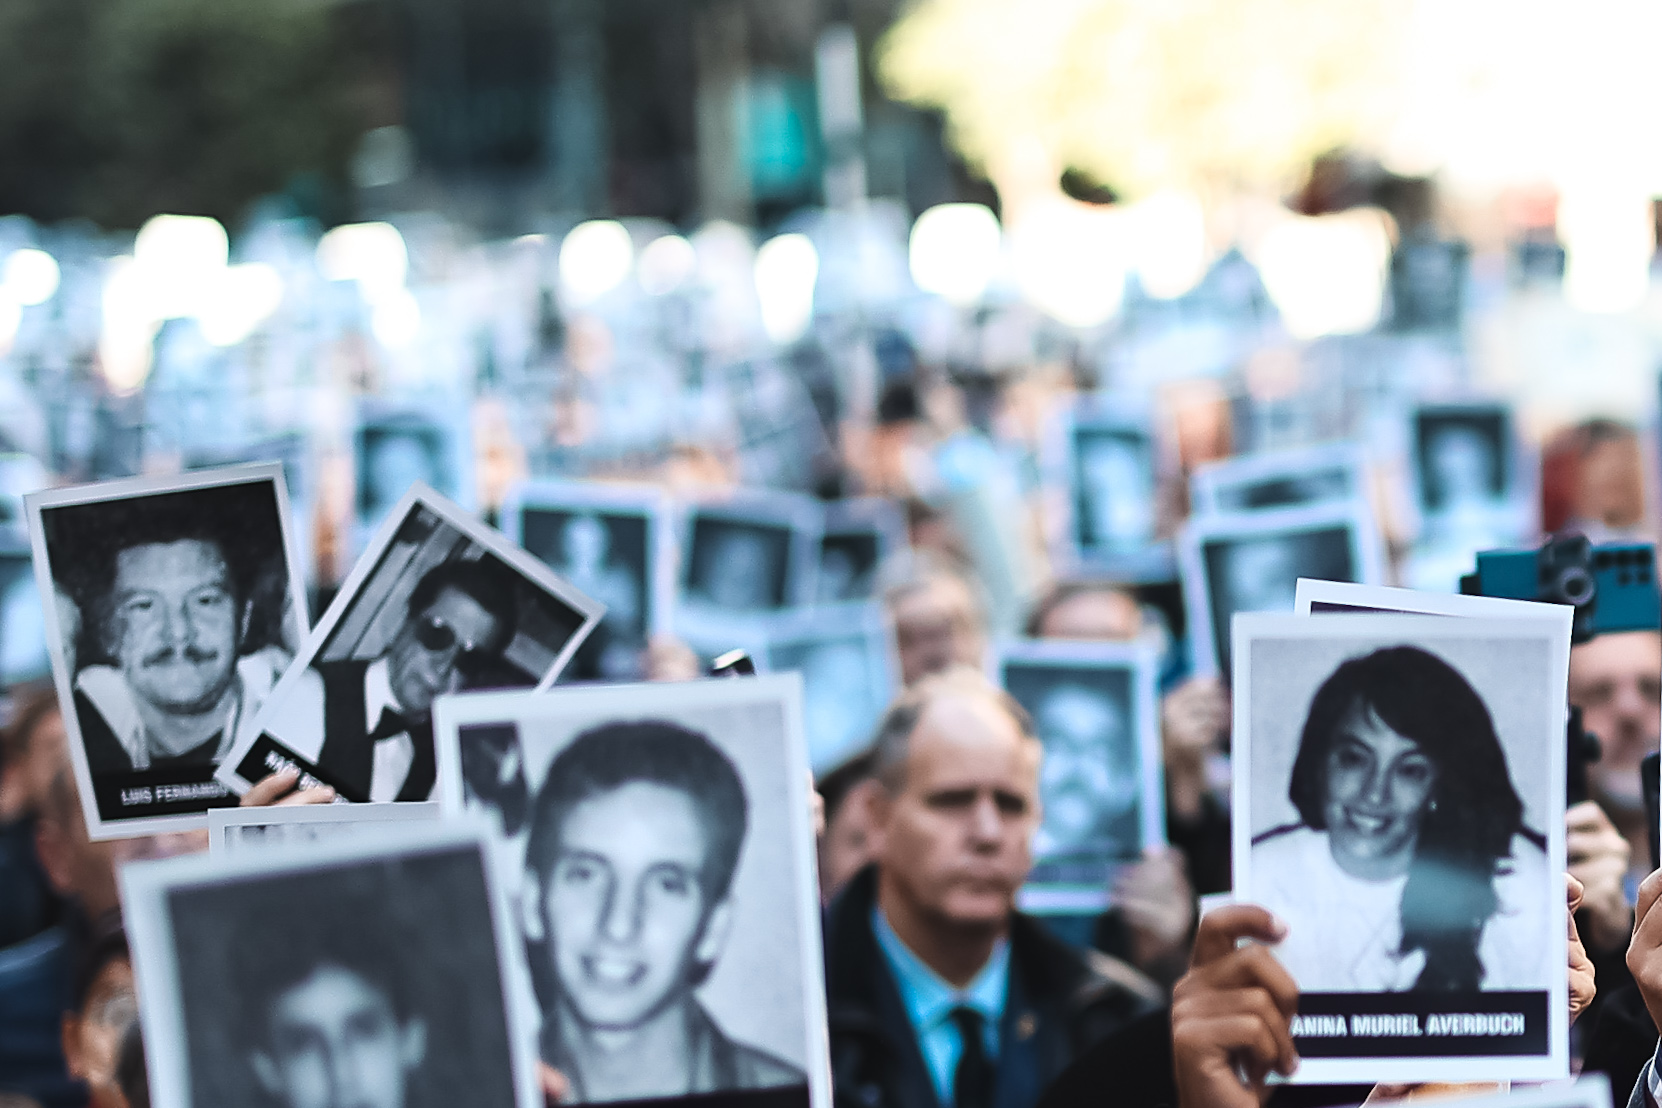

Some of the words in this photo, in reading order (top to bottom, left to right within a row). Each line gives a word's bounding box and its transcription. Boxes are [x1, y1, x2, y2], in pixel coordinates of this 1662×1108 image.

[120, 787, 152, 806] LUIS
[1291, 1014, 1348, 1037] ANINA
[1351, 1013, 1423, 1037] MURIEL
[1425, 1012, 1526, 1037] AVERBUCH
